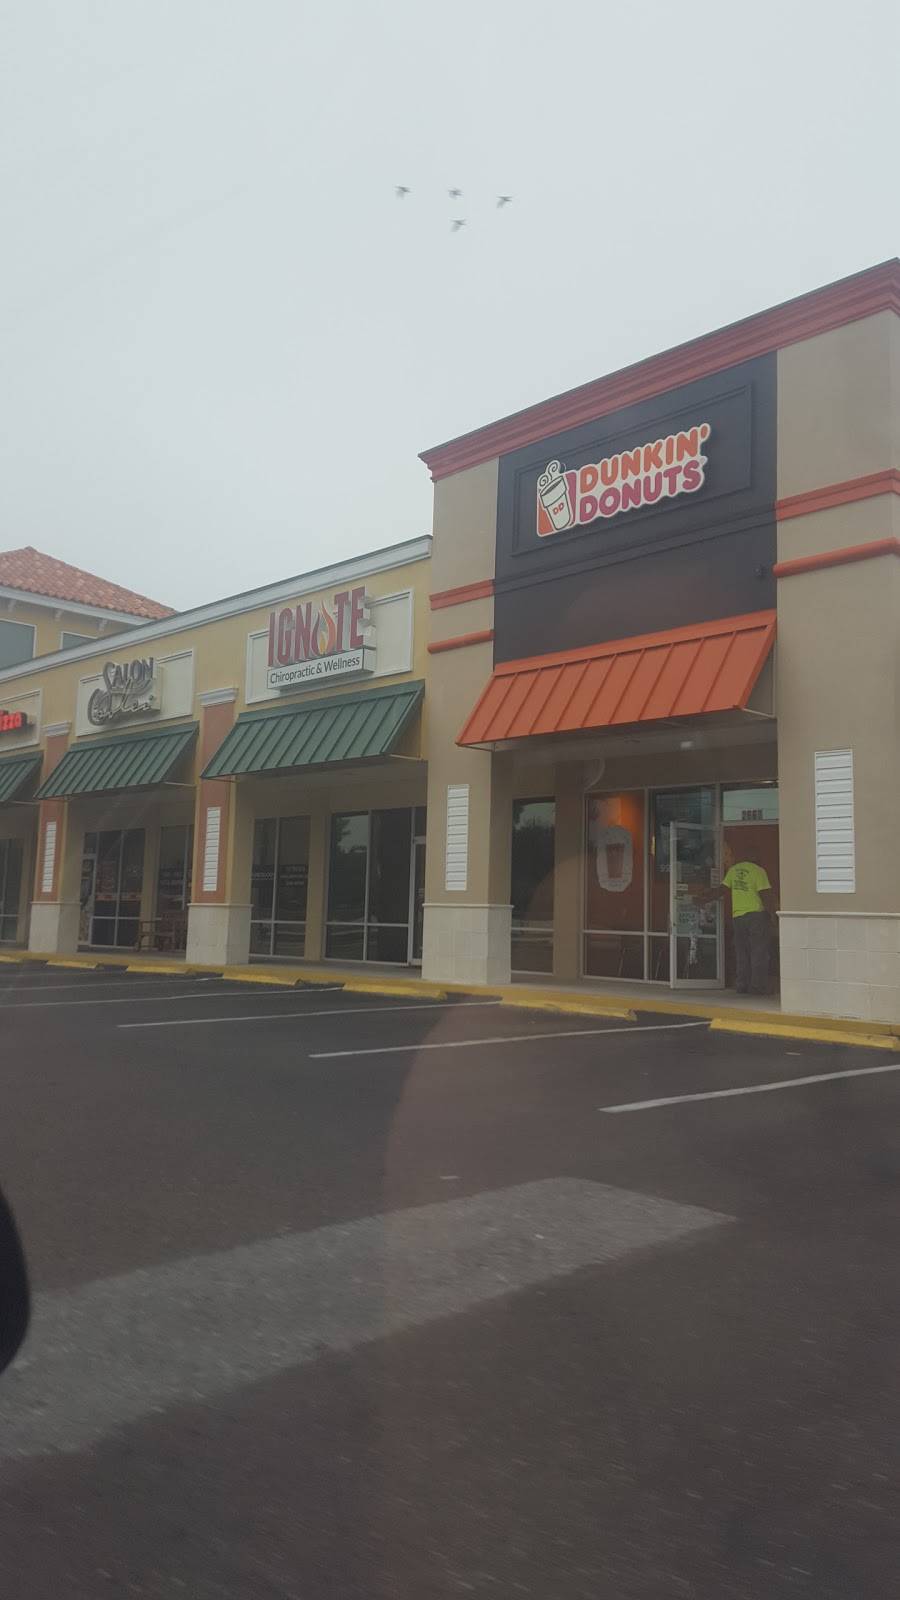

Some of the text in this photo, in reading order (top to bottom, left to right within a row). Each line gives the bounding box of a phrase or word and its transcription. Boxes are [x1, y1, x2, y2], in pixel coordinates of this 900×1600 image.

[579, 424, 709, 494] DUNKIN'
[579, 459, 701, 523] DONUTS
[269, 655, 360, 684] Chiropractic & Wellness
